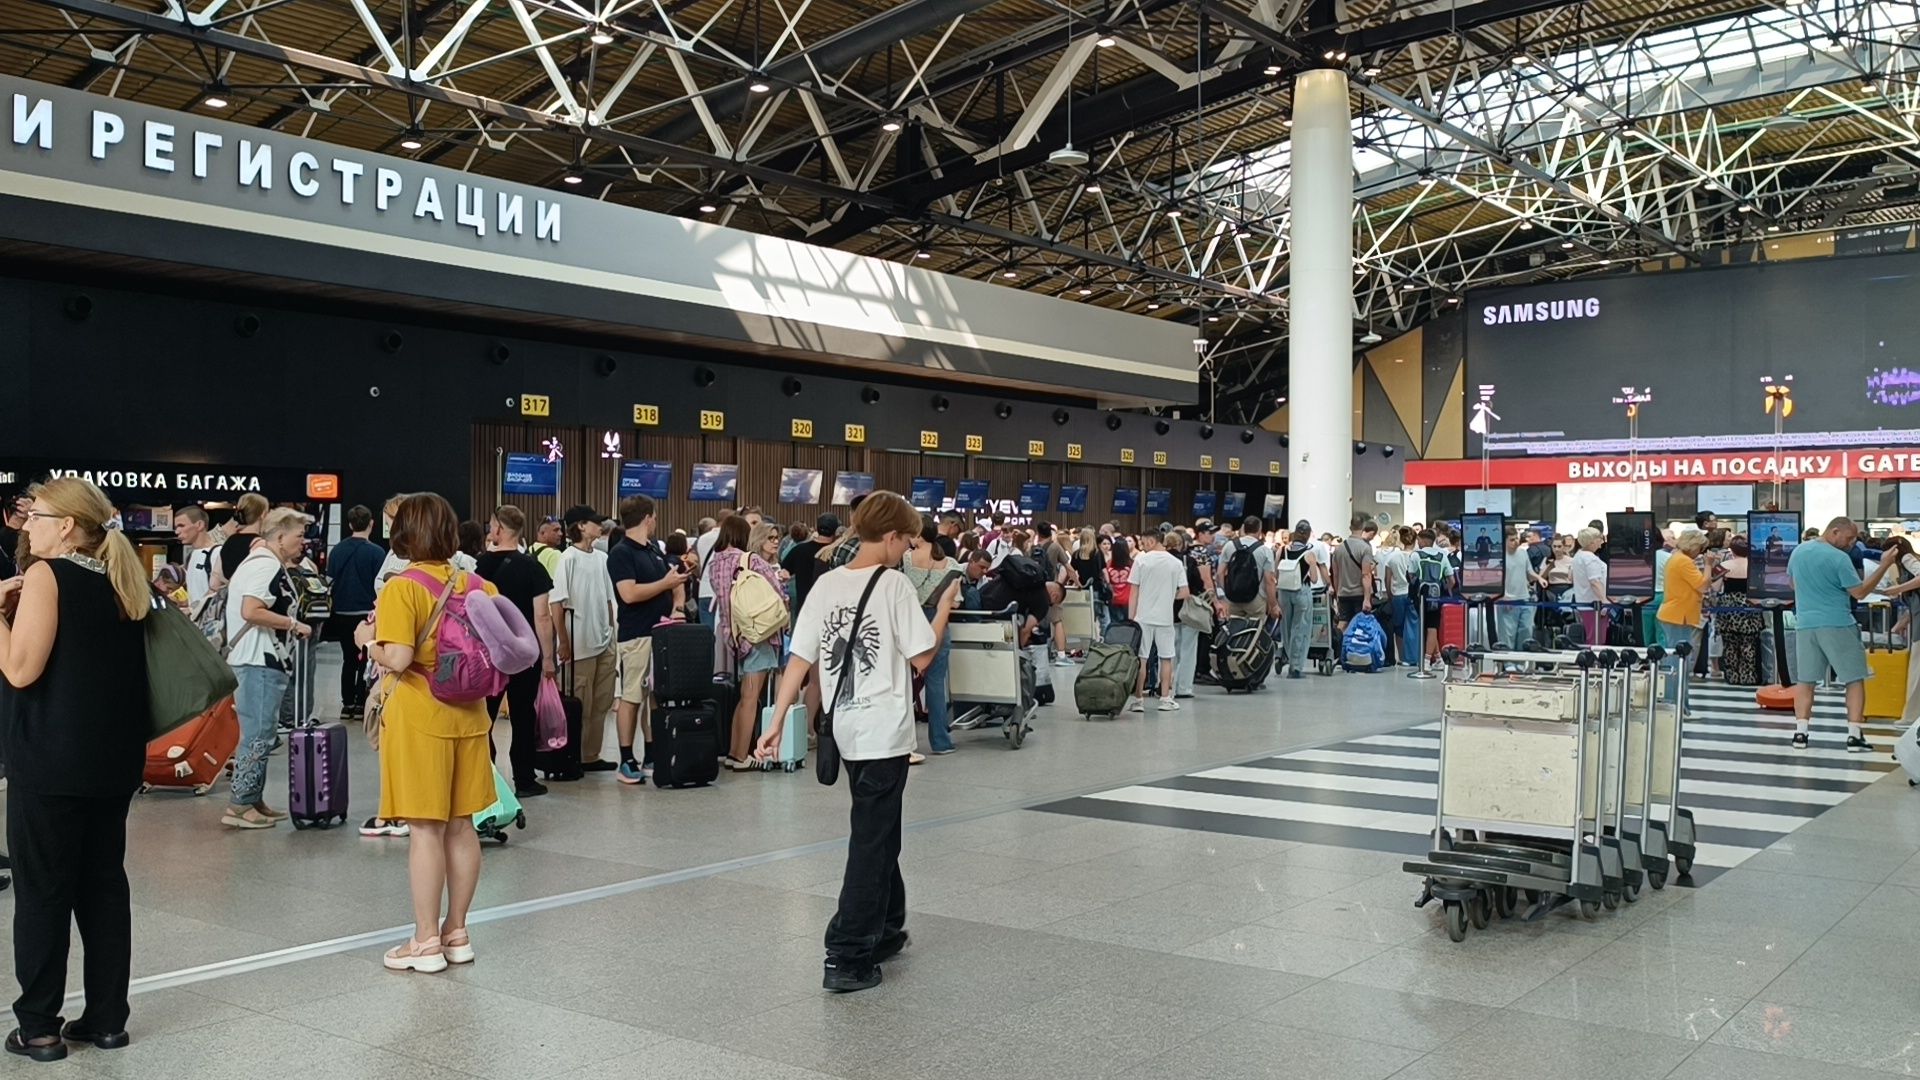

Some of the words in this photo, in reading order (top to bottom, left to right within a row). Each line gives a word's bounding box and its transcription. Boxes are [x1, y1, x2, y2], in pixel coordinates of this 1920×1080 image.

[13, 93, 52, 149] И
[91, 109, 561, 242] РЕГИСТРАЦИИ
[1483, 297, 1600, 325] SAMSUNG
[523, 398, 547, 413] 317
[636, 407, 657, 422] 318
[702, 414, 722, 428] 319
[794, 423, 811, 435] 320
[848, 427, 863, 440] 321
[922, 434, 937, 445] 322
[967, 438, 981, 449] 323
[1030, 443, 1043, 453] 324
[1068, 446, 1081, 457] 325
[1155, 453, 1166, 464] 327
[1568, 460, 1667, 480] ВЫХОДЫ
[1674, 459, 1706, 476] НА
[1712, 456, 1831, 477] ПОСАДКУ
[176, 474, 261, 491] БАГАЖА
[1110, 569, 1129, 583] 22
